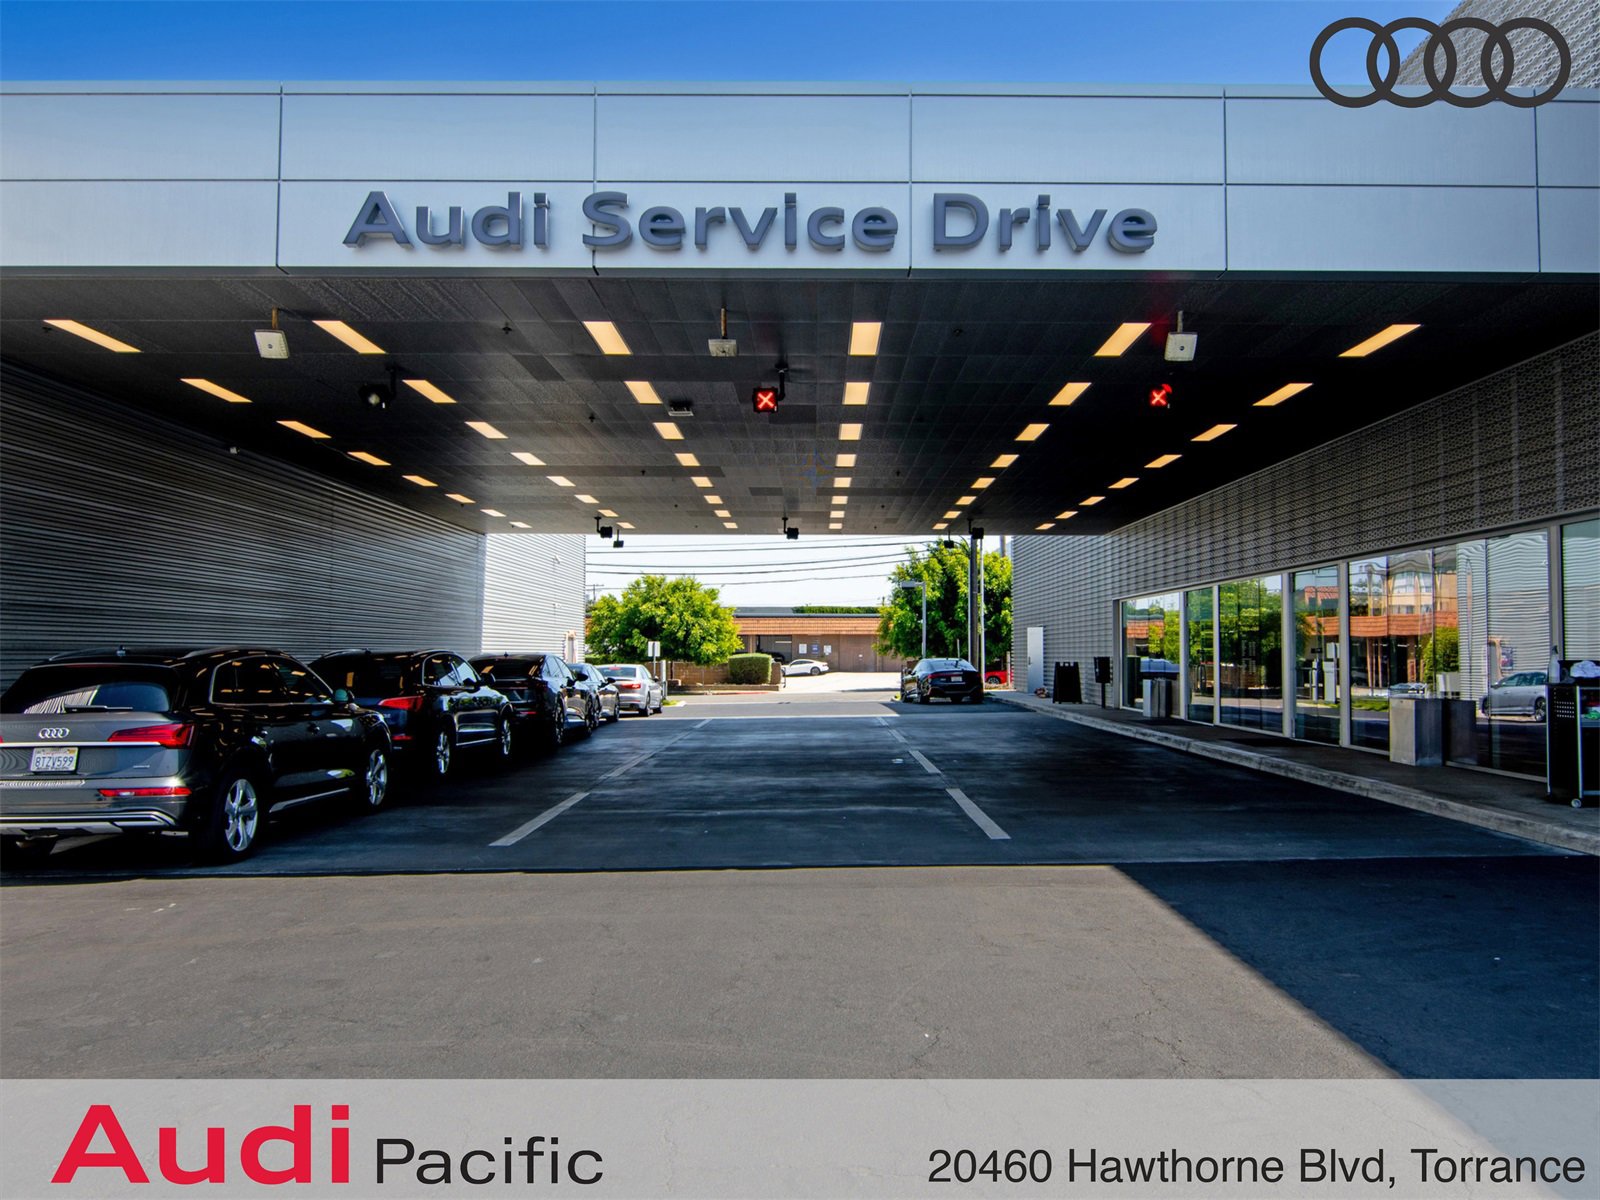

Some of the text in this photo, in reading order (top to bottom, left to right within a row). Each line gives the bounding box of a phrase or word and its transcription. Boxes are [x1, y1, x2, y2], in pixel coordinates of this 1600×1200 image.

[342, 191, 1158, 253] Audi Service Drive
